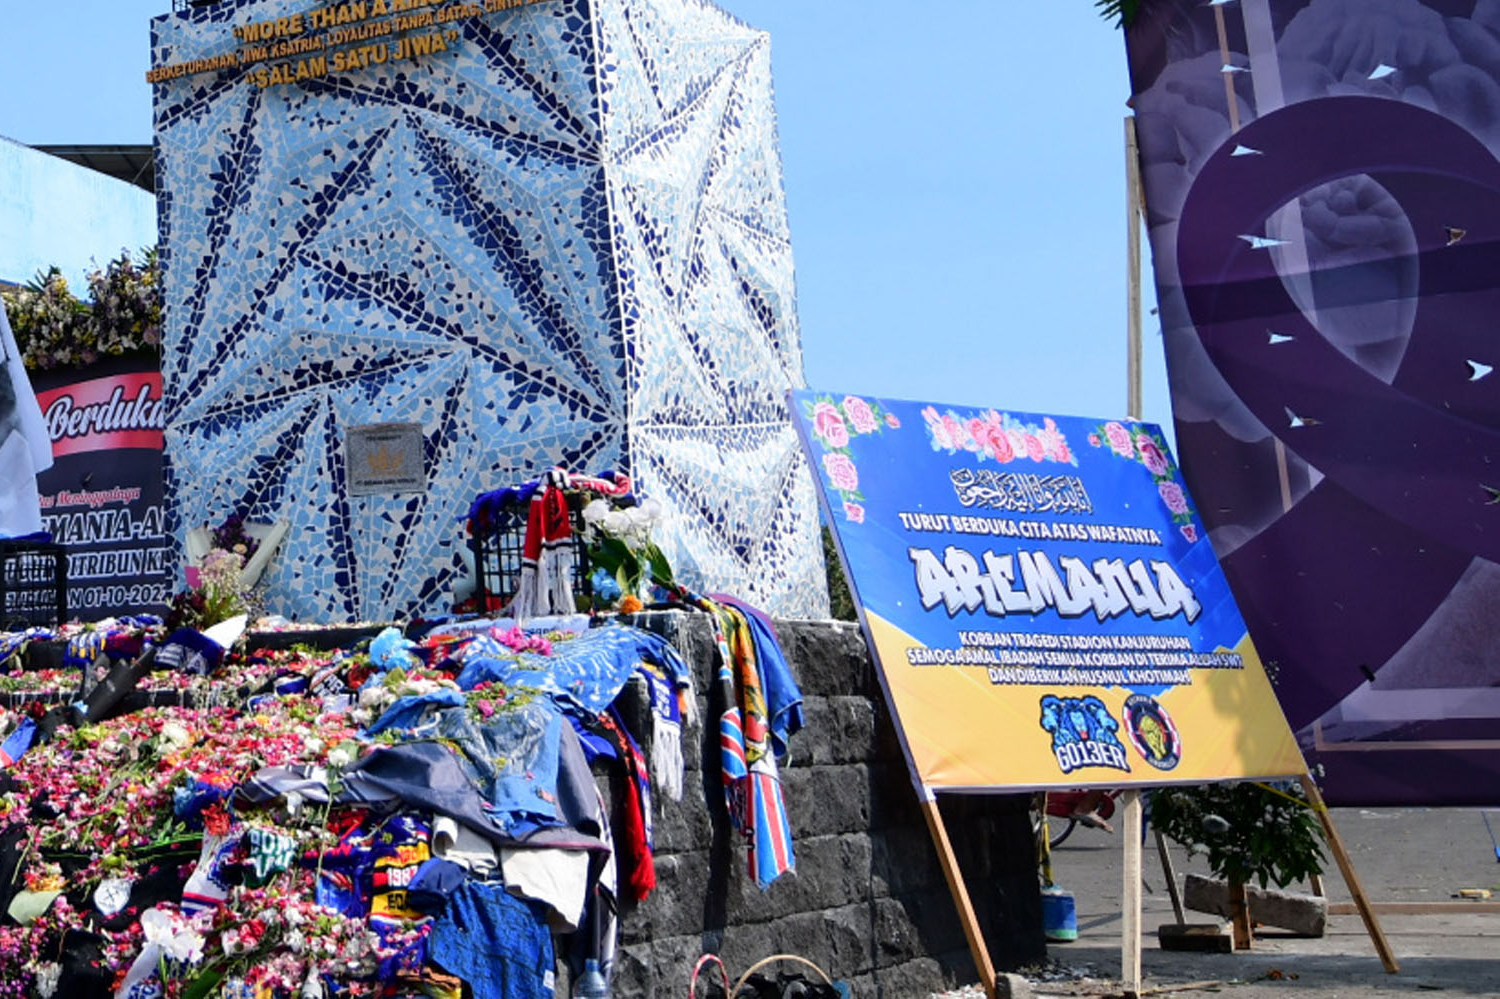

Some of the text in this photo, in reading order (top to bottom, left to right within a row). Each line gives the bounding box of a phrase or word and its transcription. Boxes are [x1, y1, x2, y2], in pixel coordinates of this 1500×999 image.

[310, 0, 368, 29] THAN
[241, 45, 269, 64] JIWA
[271, 36, 326, 57] KSATRIA,
[326, 21, 392, 46] LOYALITAS
[394, 14, 434, 30] TANPA
[435, 4, 483, 24] BATAS,
[331, 44, 389, 72] SATU
[50, 384, 165, 443] Berduka
[898, 512, 1163, 546] TURUT BERDUKA CITA ATAS WAFATNYA
[66, 548, 143, 579] ITRIBUN
[908, 546, 1202, 624] AREMANIA
[959, 631, 1192, 650] KORBAN TRAGEDI STADION KANJURUHAN
[906, 648, 967, 665] SEMOGA
[965, 650, 1000, 665] AMAL
[1000, 650, 1046, 667] IBADAH
[1045, 651, 1084, 667] SEMUA
[1083, 652, 1136, 668] KORBAN
[1135, 653, 1150, 667] DI
[1149, 653, 1190, 668] TERIMA
[1188, 653, 1223, 669] ALLAH
[988, 668, 1193, 685] DAN DIBERIKAN HUSNUL KHOTIMAH
